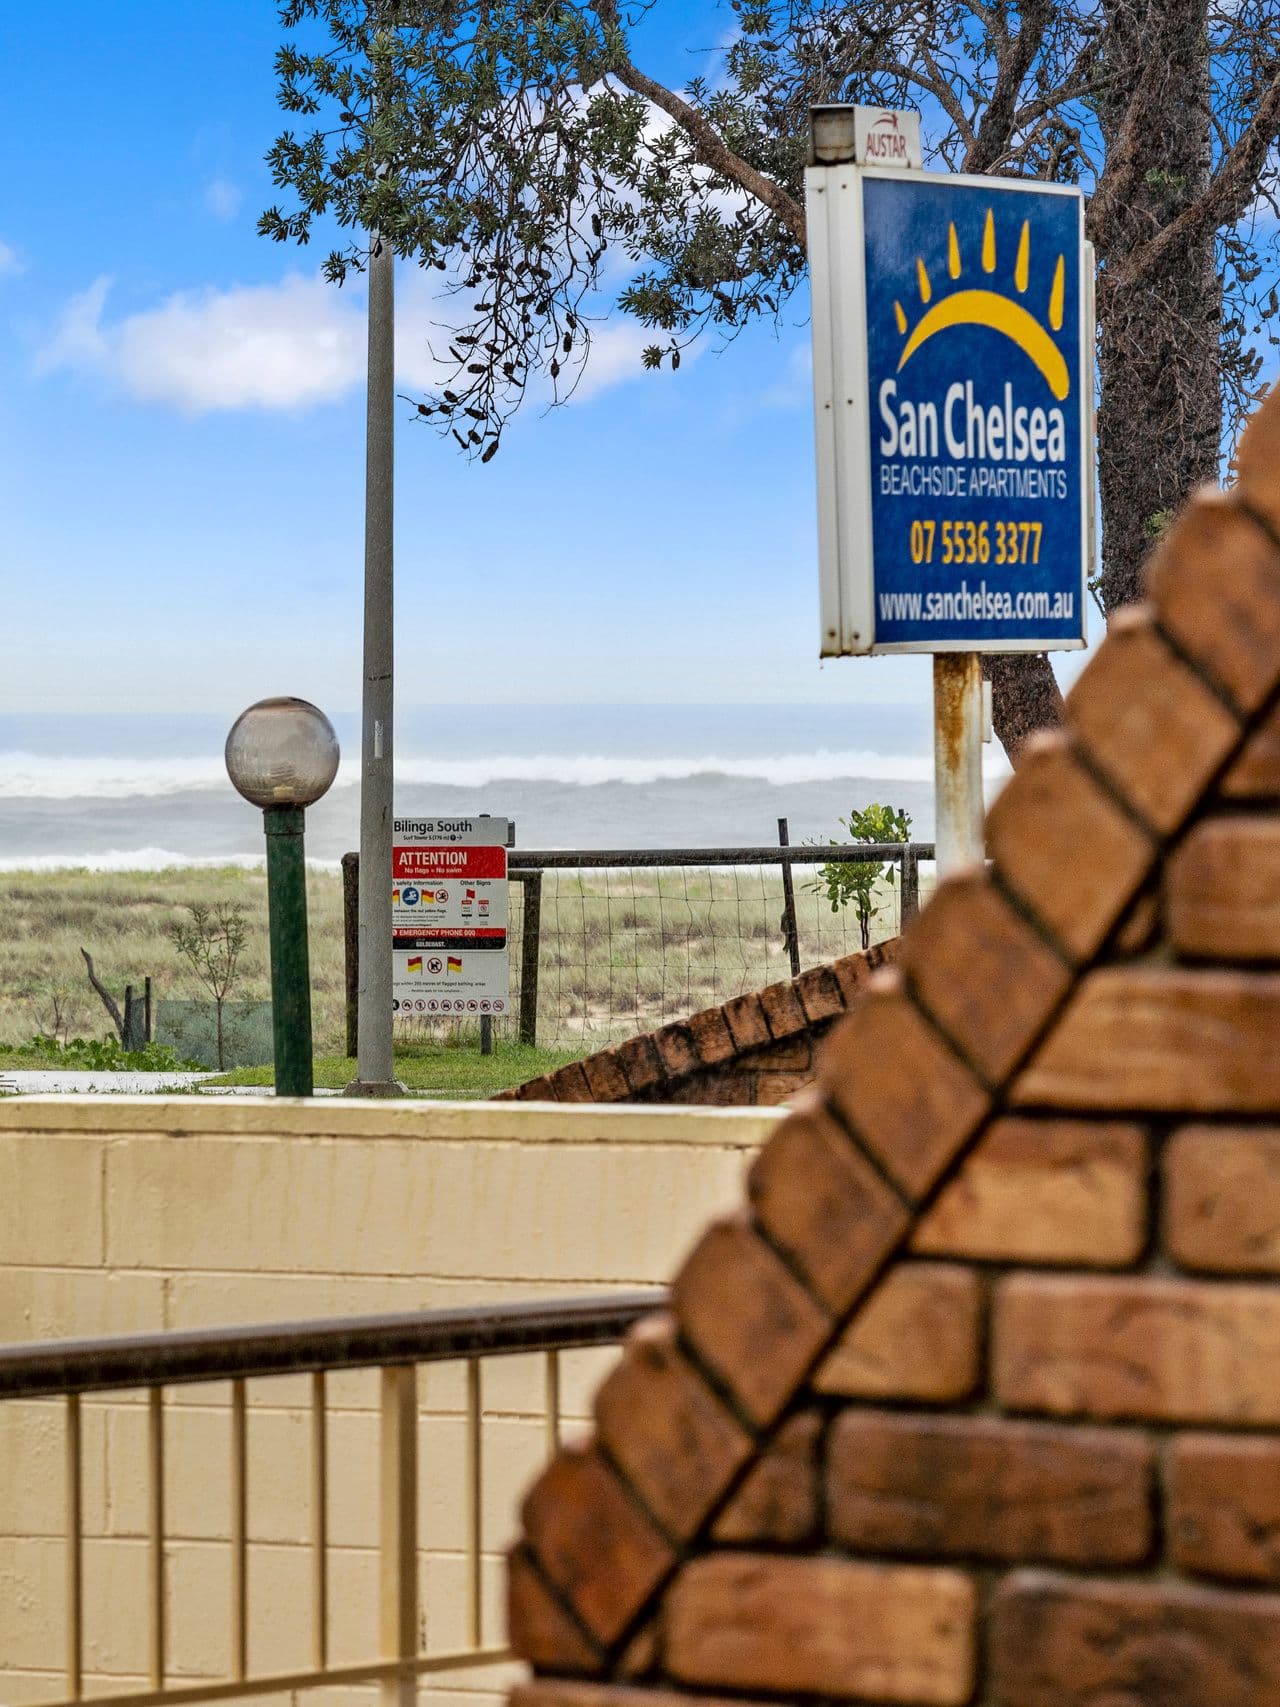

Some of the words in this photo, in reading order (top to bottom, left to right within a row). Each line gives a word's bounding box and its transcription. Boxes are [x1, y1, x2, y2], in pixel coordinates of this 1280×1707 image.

[865, 133, 907, 158] AUSTAR
[879, 378, 938, 457] San
[943, 380, 1065, 462] Chelsea
[880, 465, 966, 497] BEACHSIDE
[969, 467, 1067, 499] APARTMENTS
[910, 520, 936, 564] 07
[942, 520, 990, 564] 5536
[995, 521, 1043, 564] 3377
[879, 580, 1074, 621] www.sanchelsea.com.au
[394, 820, 434, 835] Bilinga
[437, 820, 472, 832] South
[399, 851, 468, 866] ATTENTION
